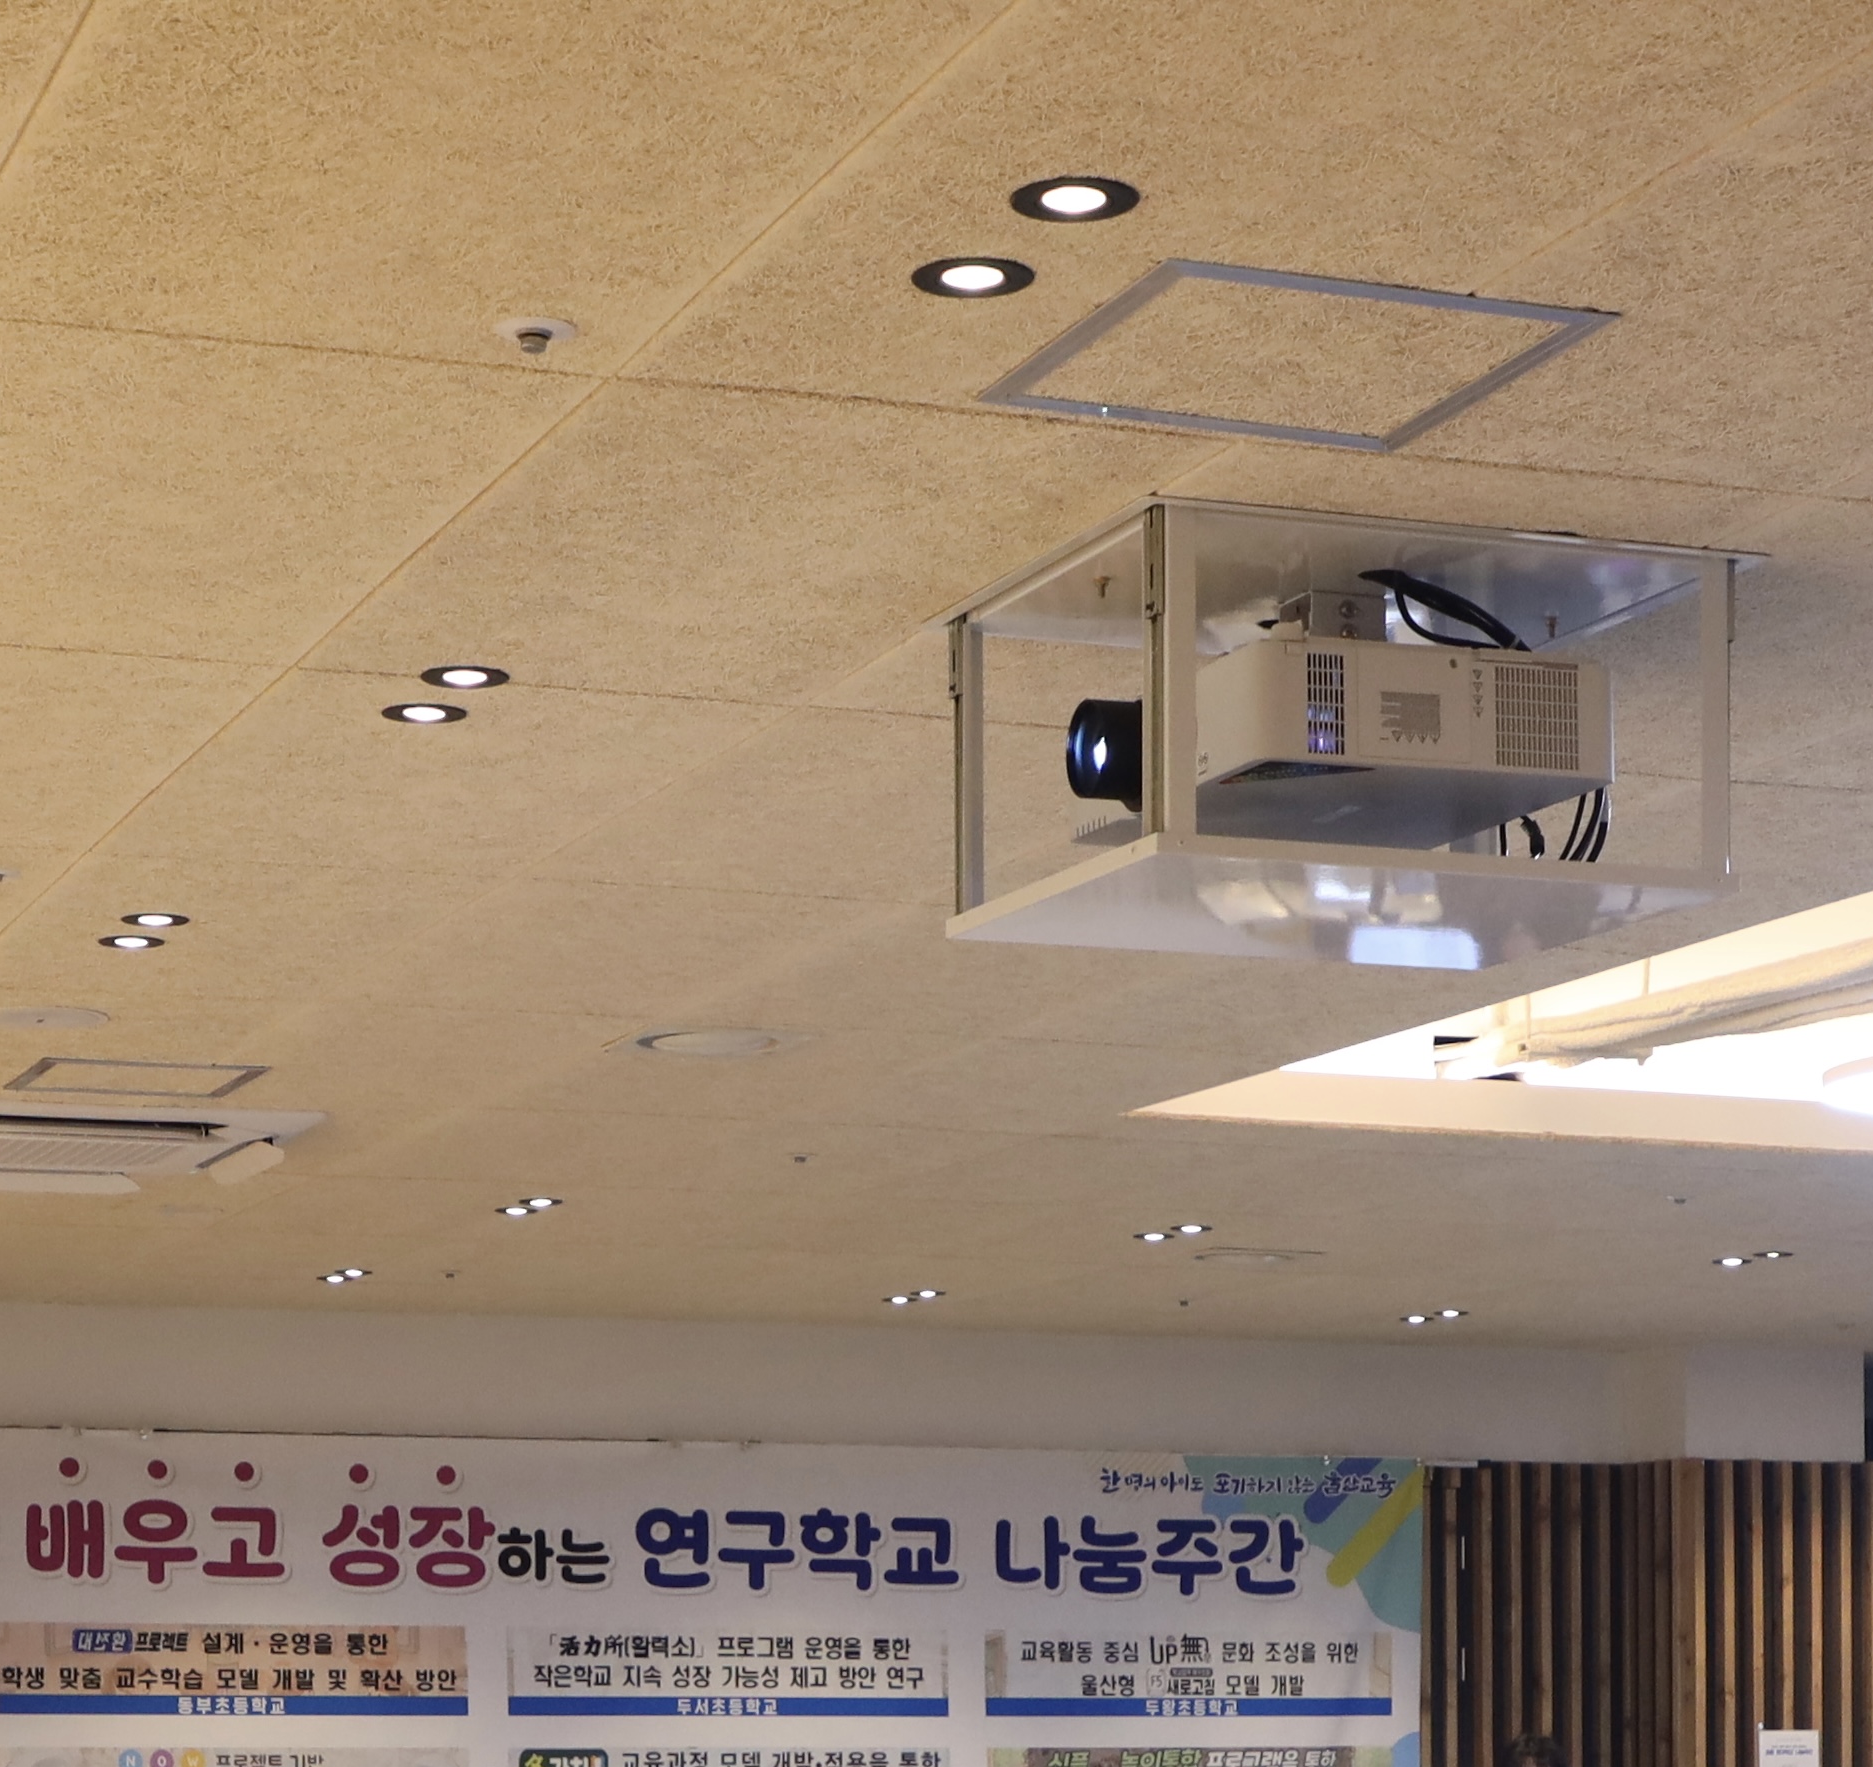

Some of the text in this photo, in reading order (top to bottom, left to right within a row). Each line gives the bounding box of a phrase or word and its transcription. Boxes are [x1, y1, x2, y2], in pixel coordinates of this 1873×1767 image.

[1099, 1467, 1396, 1498] 한 명의 아이도 포기하지 않는 울산교육
[26, 1499, 286, 1585] 배우고
[322, 1505, 610, 1588] 성장하는
[635, 1507, 958, 1590] 연구학교
[995, 1512, 1304, 1596] 나눔주간
[134, 1632, 388, 1655] 프로젝트 통한
[717, 1636, 793, 1660] 프로그램
[804, 1636, 861, 1660] 운영을
[872, 1636, 911, 1661] 통한
[1020, 1640, 1358, 1664] 교육활동 중심 문화 조성을 위한
[1, 1667, 457, 1691] 학생 맞춤 교수학습 모델 개발 및 확산 방안
[533, 1664, 925, 1689] 작은학교 지속 성장 가능성 제고 방안 연구
[1080, 1674, 1305, 1697] 울산형 새로고침 모델 개발
[176, 1696, 286, 1715] 동부초등학교
[677, 1698, 779, 1716] 두서초등학교
[1145, 1699, 1239, 1716] 두왕초등학교
